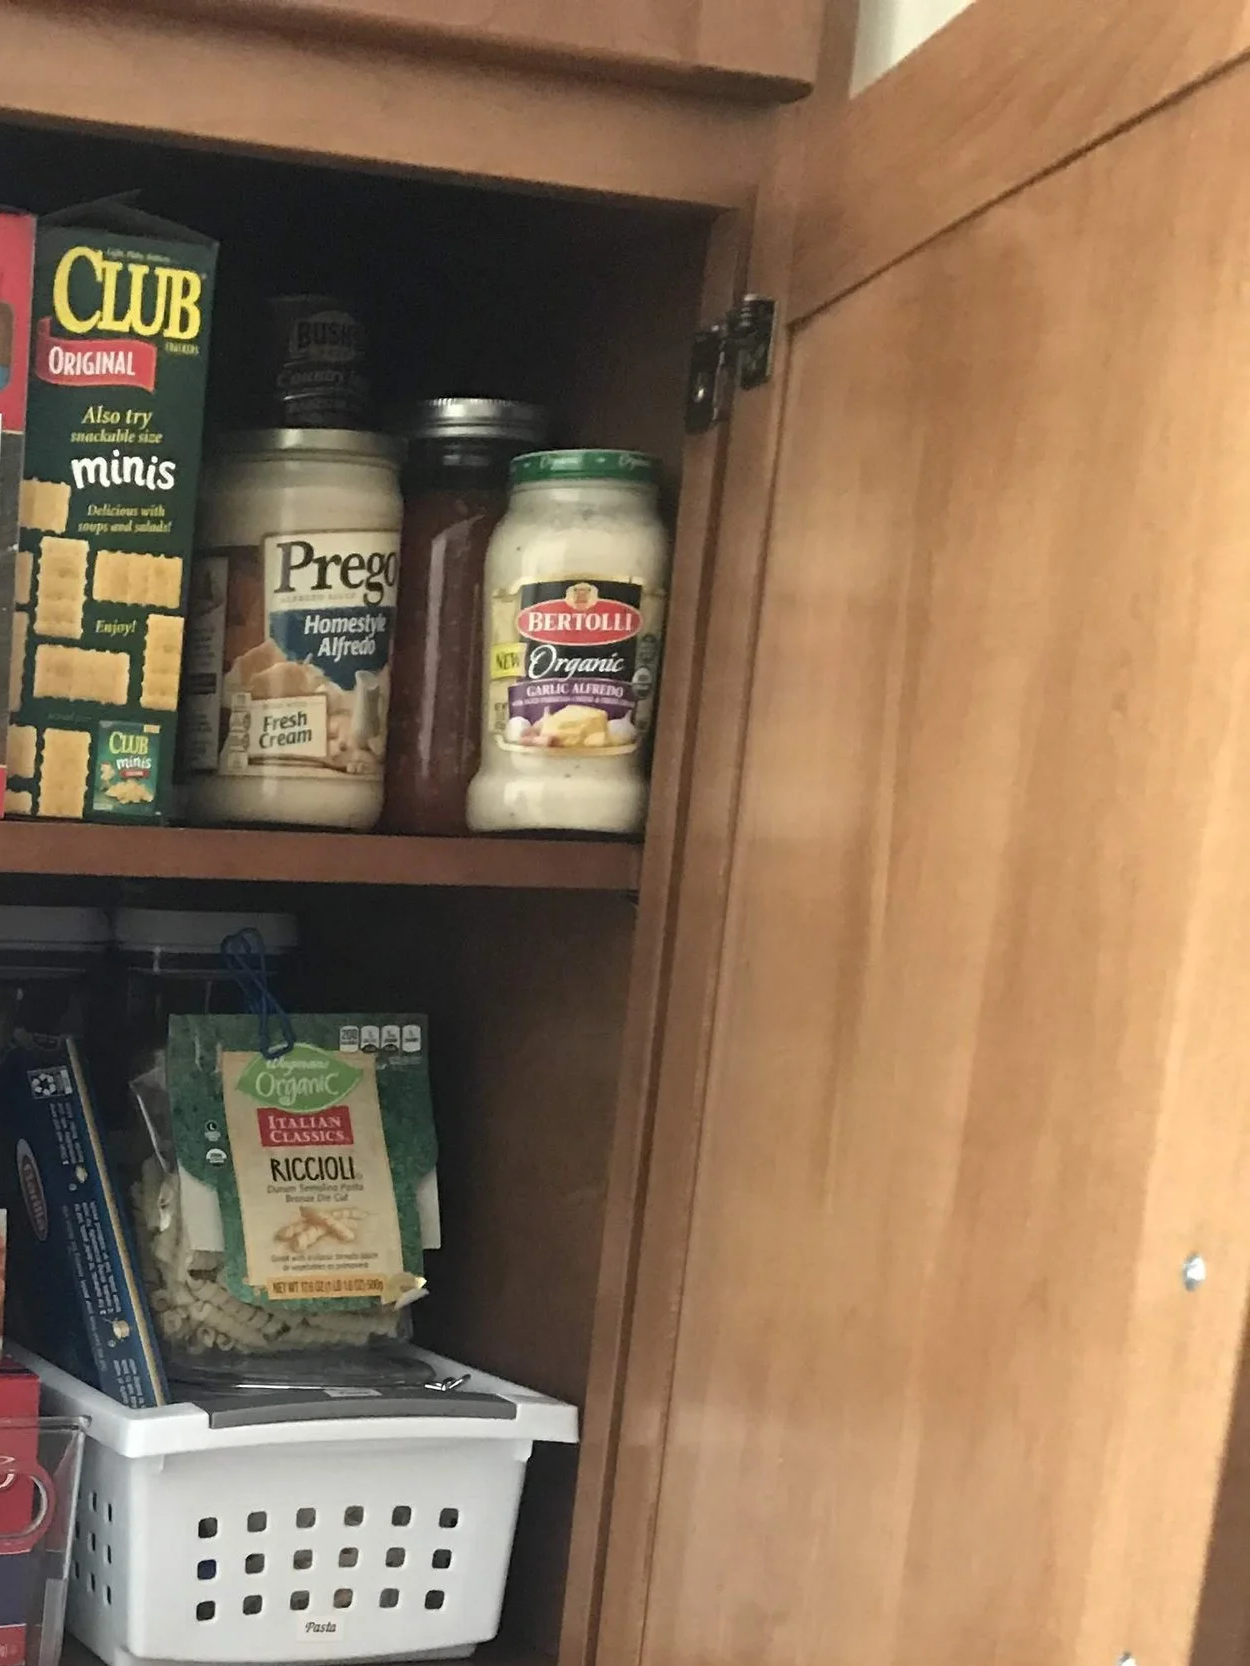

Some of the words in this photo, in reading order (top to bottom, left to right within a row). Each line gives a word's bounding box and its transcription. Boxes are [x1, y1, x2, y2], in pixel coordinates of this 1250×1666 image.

[53, 245, 202, 340] CLUB
[49, 346, 136, 376] ORIGINAL
[81, 405, 121, 424] Also
[125, 408, 153, 431] try
[70, 428, 135, 443] snackable
[137, 430, 163, 444] size
[70, 449, 176, 490] minis
[87, 503, 138, 517] Delicious
[140, 504, 165, 517] with
[77, 521, 109, 536] soups
[110, 519, 132, 533] and
[272, 540, 397, 607] Prego
[94, 619, 137, 637] Enjoy!
[304, 613, 387, 637] Homestyle
[528, 611, 633, 632] BERTOLLI
[318, 636, 377, 663] Alfredo
[495, 650, 520, 670] NEW
[528, 644, 625, 682] Organic
[526, 683, 568, 698] GARLIC
[572, 682, 624, 698] ALFREDO
[262, 711, 308, 732] Fresh
[108, 731, 149, 755] CLUB
[259, 728, 313, 750] Cream
[116, 755, 152, 772] minis
[255, 1071, 339, 1106] Organic
[268, 1115, 342, 1130] ITALIAN
[270, 1129, 345, 1143] CLASSICS
[270, 1156, 356, 1182] RICCIOLI
[305, 1621, 337, 1633] Pasta
